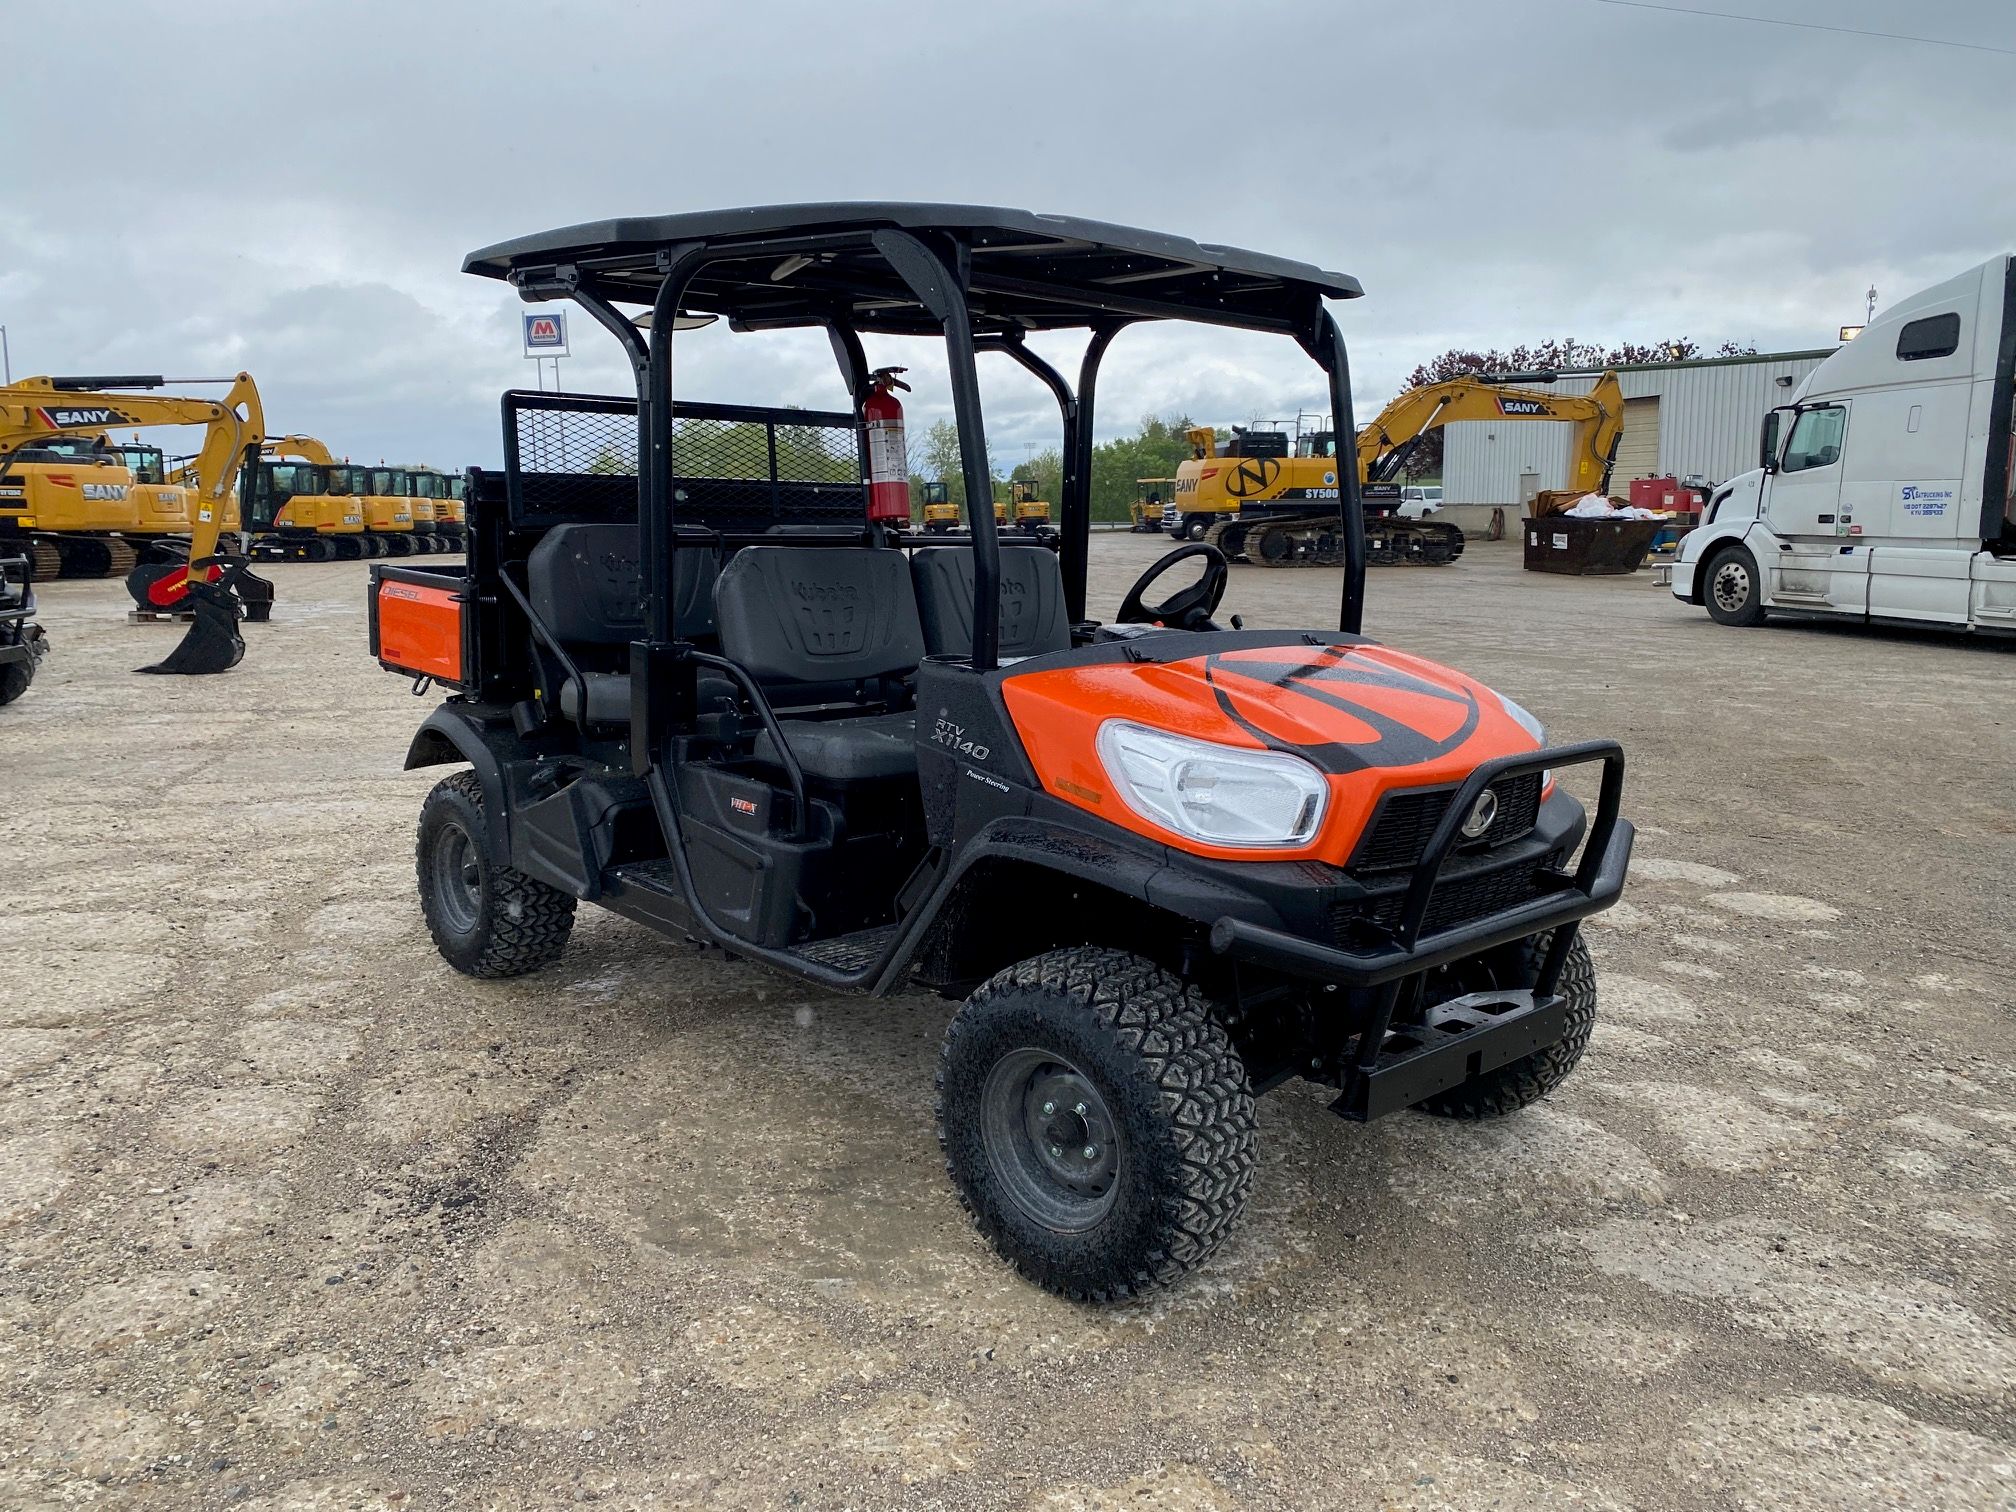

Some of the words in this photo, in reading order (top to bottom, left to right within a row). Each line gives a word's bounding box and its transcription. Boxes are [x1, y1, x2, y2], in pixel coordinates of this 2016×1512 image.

[1505, 403, 1540, 413] SANY
[56, 410, 110, 424] SANY
[82, 484, 127, 501] SANY
[1176, 478, 1198, 492] SANY
[936, 719, 965, 736] RTV
[931, 728, 989, 760] X1140
[966, 769, 985, 782] Power
[984, 777, 1010, 793] Steering
